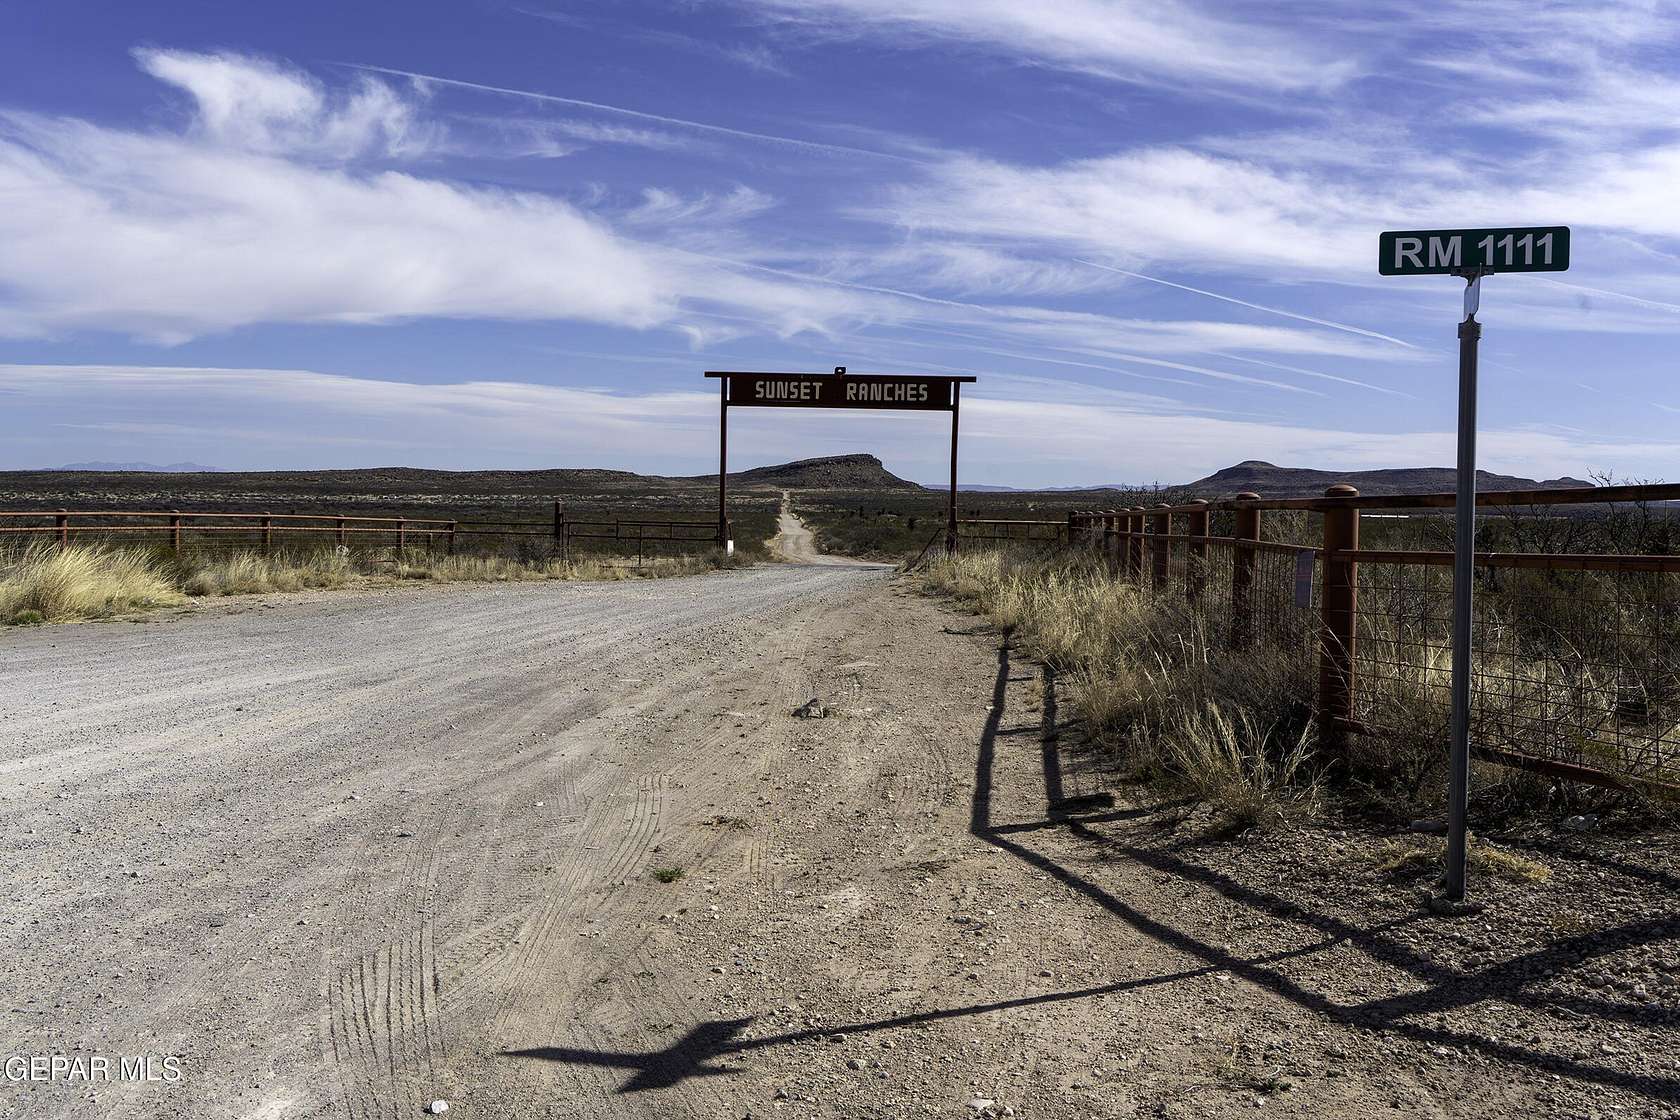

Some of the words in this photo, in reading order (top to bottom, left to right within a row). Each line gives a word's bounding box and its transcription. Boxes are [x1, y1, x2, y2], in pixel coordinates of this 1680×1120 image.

[1394, 235, 1462, 269] RM
[1478, 232, 1553, 266] 1111
[755, 380, 823, 400] SUNSET
[846, 382, 928, 401] RANCHES
